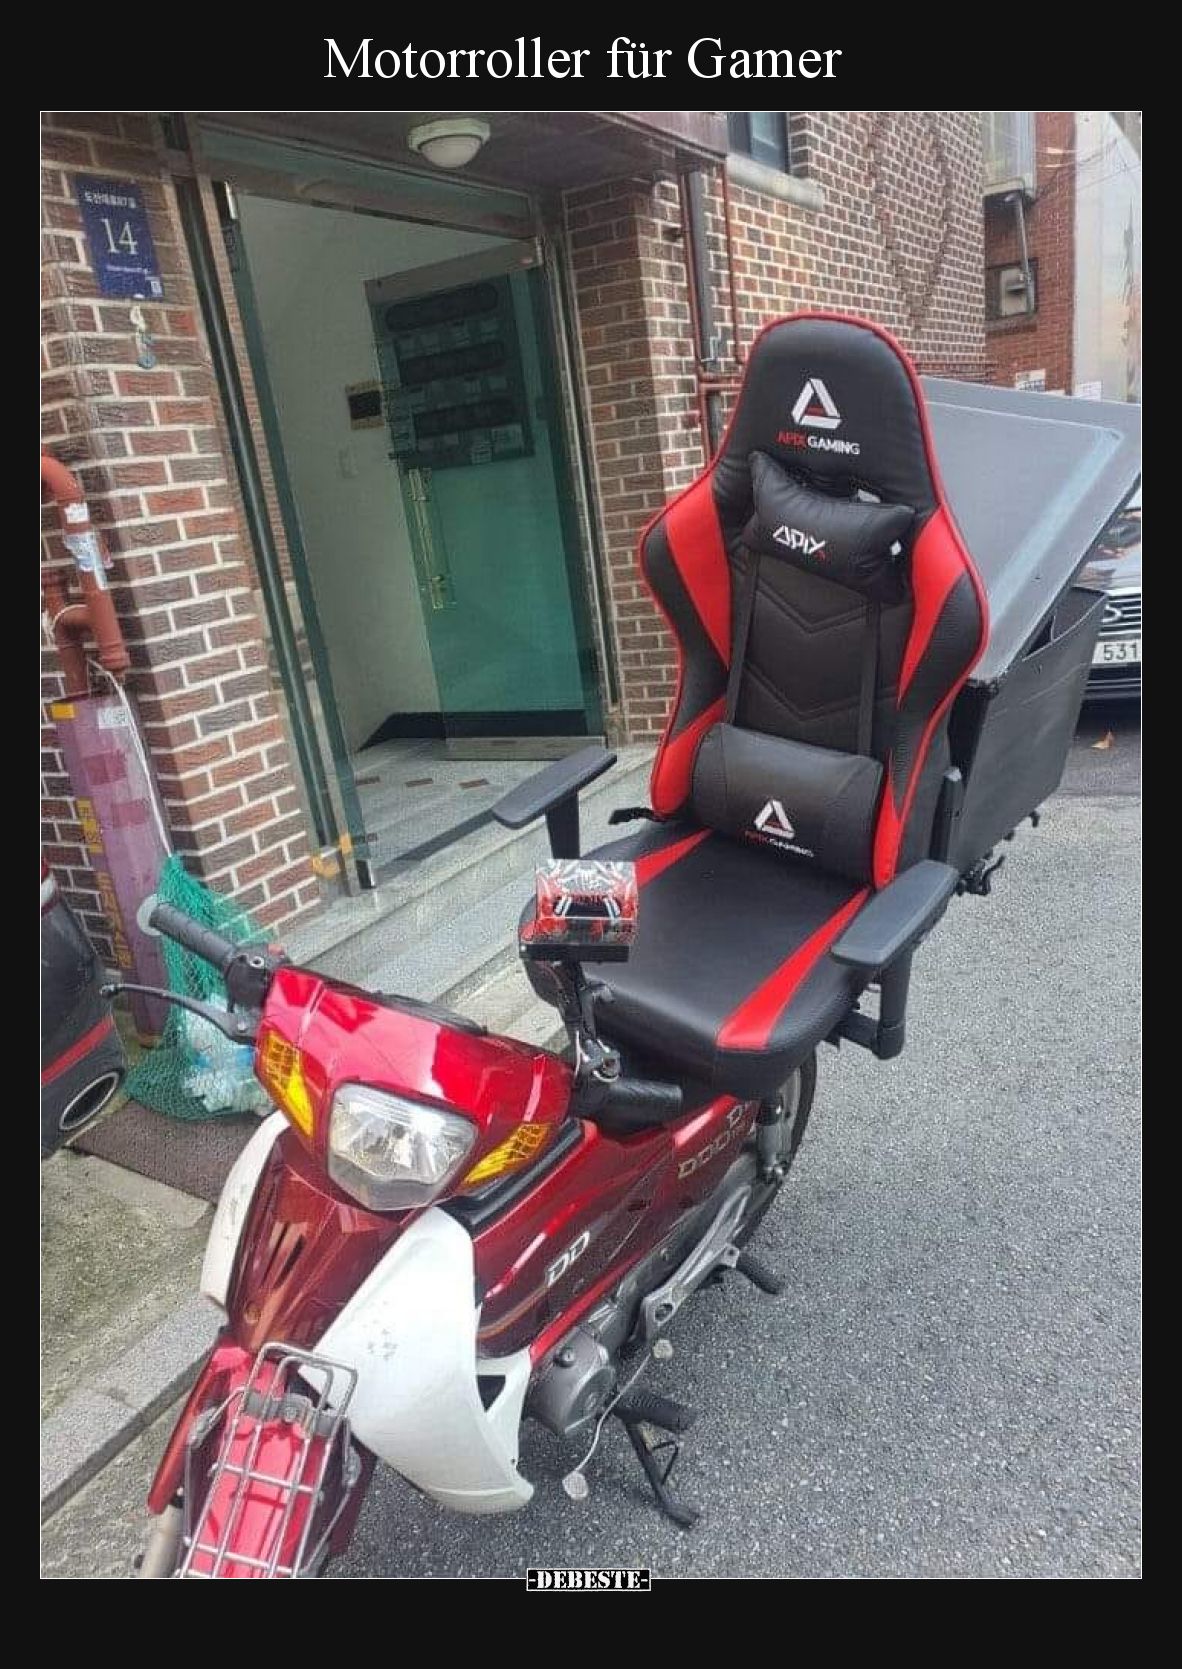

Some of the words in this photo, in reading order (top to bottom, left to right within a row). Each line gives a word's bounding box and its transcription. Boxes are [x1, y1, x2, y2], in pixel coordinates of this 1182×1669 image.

[102, 218, 138, 255] 14
[807, 436, 861, 455] GAMING
[1103, 643, 1138, 661] 531
[547, 1230, 590, 1288] DD
